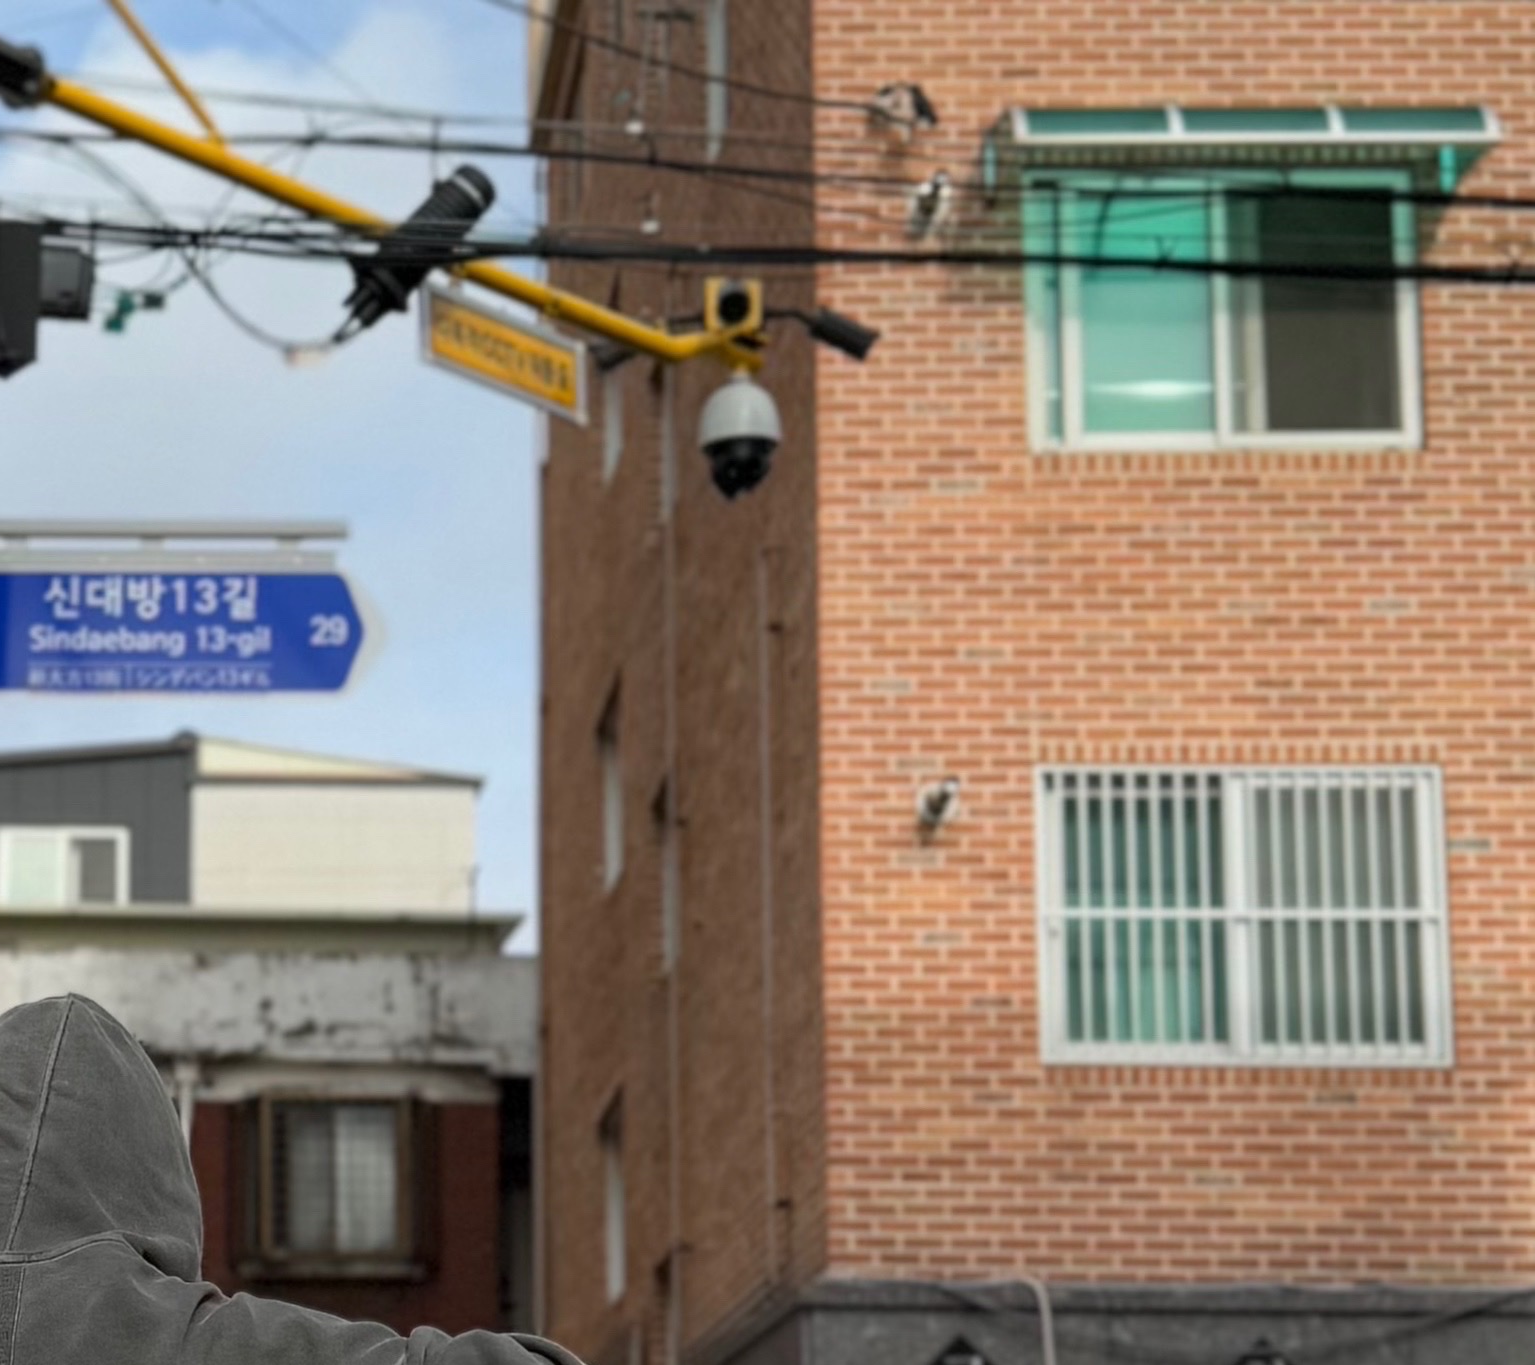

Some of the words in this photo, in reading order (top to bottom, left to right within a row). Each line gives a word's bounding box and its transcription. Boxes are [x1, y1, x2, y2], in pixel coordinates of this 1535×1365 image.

[44, 575, 258, 621] 신대방13길
[29, 624, 187, 657] Sindaebang
[196, 625, 272, 657] 13-gil
[309, 615, 349, 647] 29
